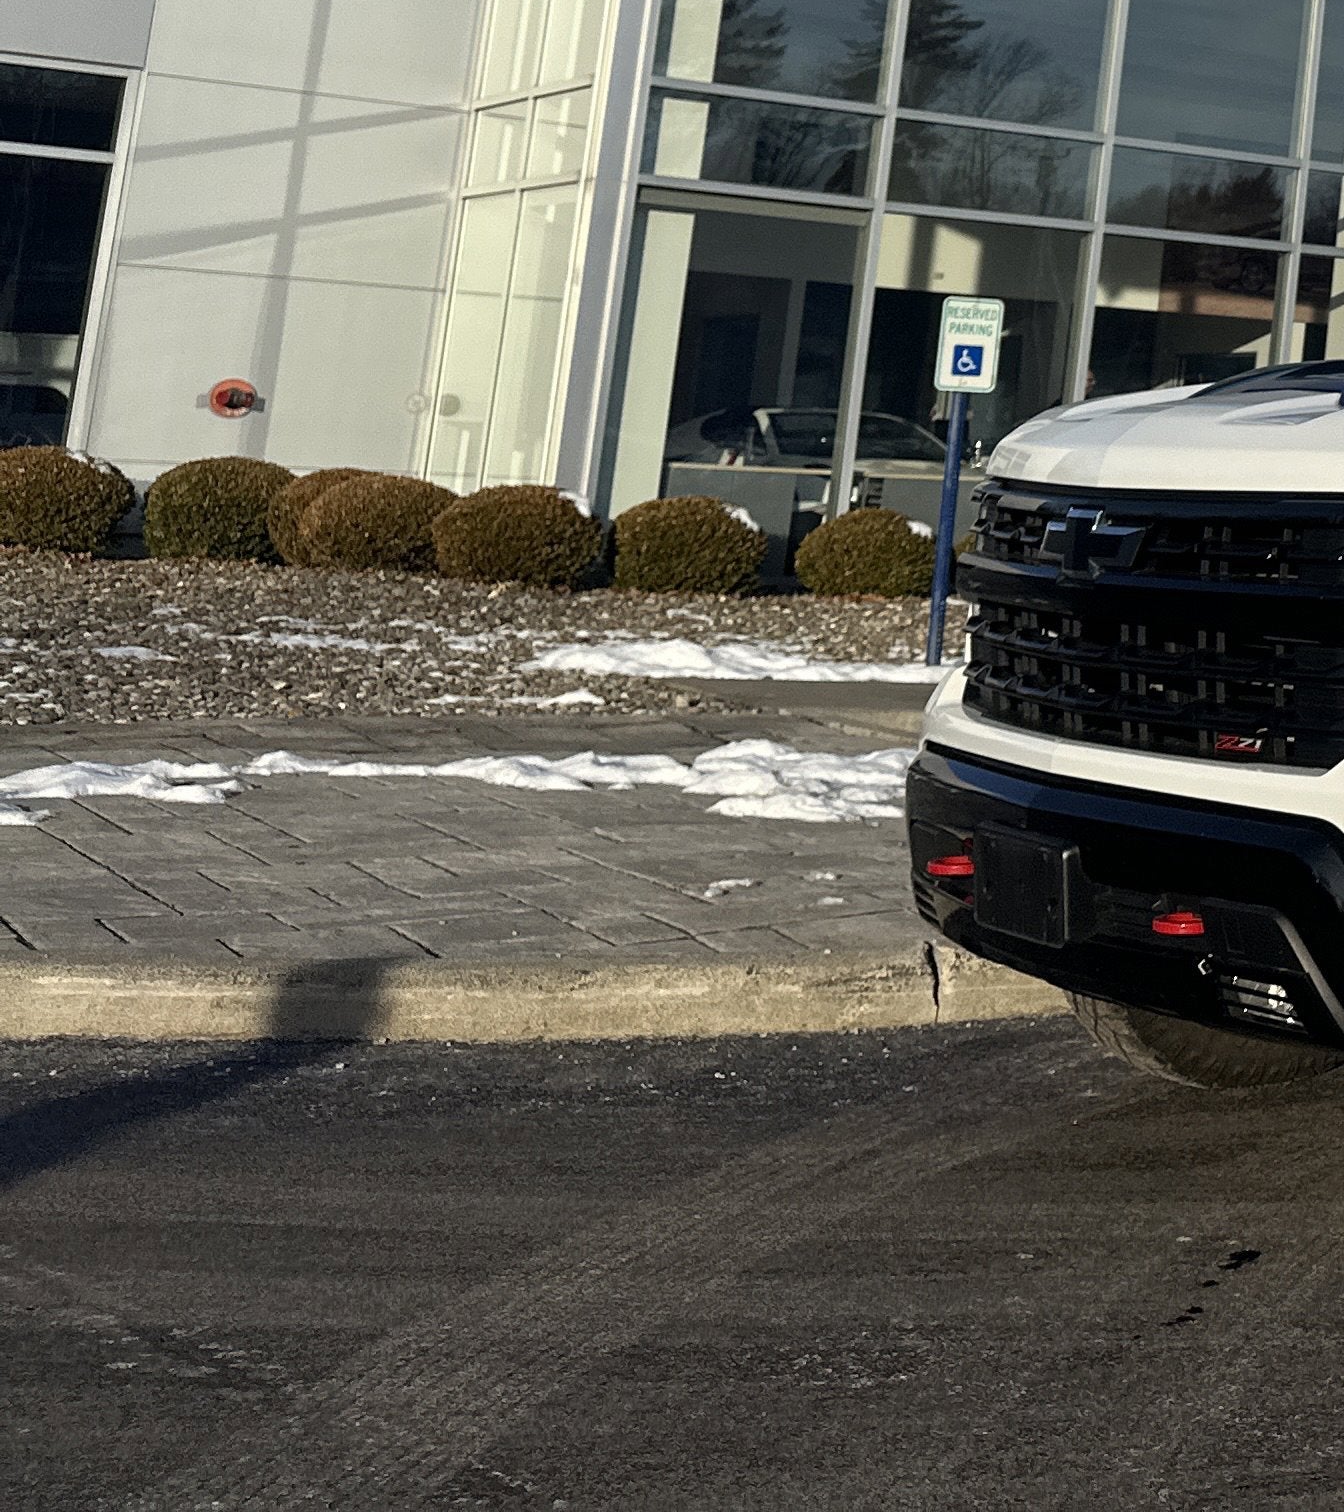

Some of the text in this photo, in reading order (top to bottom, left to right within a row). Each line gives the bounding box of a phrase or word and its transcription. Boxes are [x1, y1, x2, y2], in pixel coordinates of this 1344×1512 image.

[948, 307, 997, 321] RESERVED
[949, 322, 993, 337] PARKING
[1215, 734, 1262, 753] Z71
